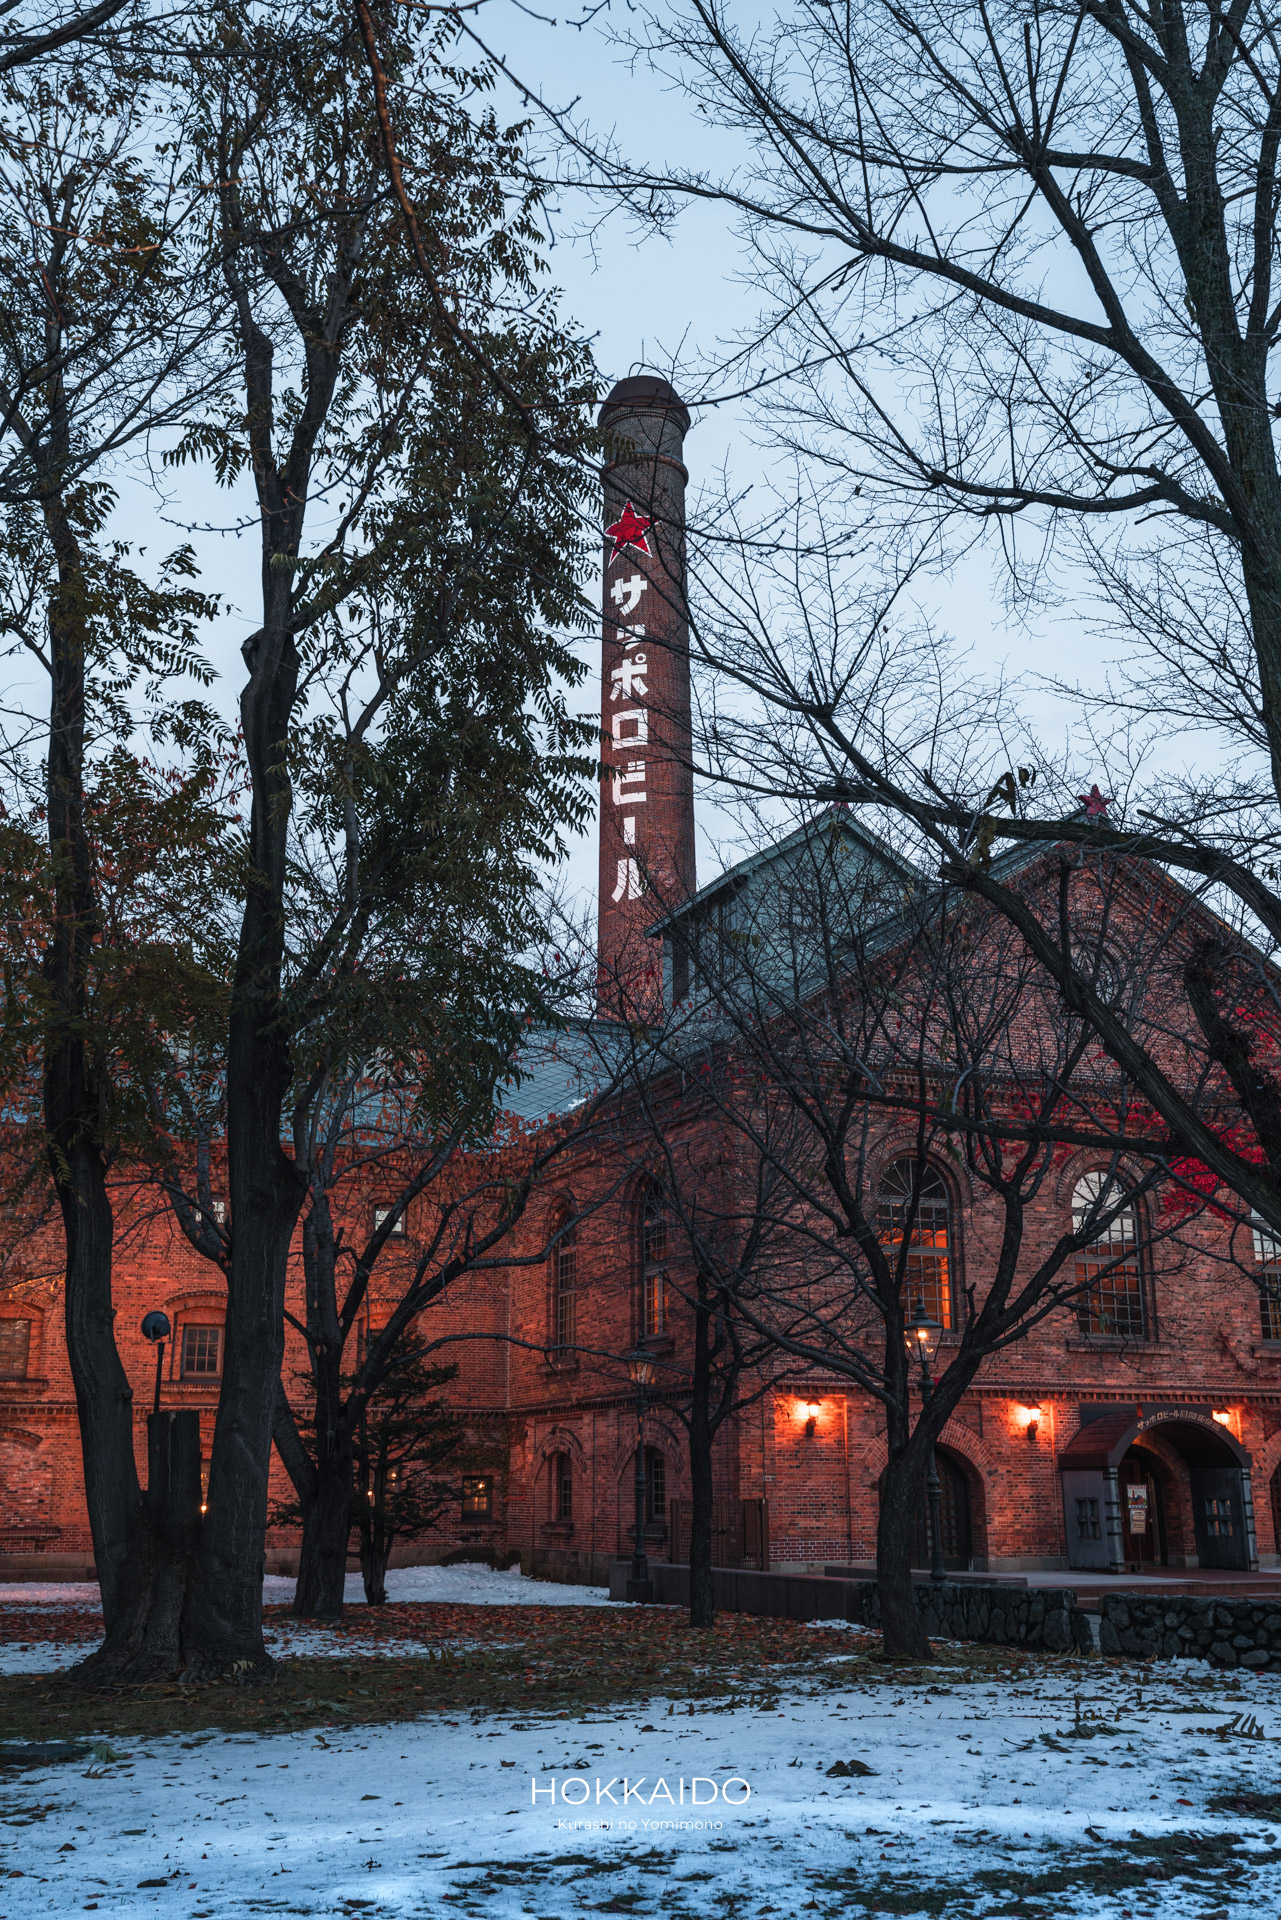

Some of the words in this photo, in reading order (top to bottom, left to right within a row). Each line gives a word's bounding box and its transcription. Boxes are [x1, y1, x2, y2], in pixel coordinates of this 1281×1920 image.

[610, 574, 648, 903] サッポロビール
